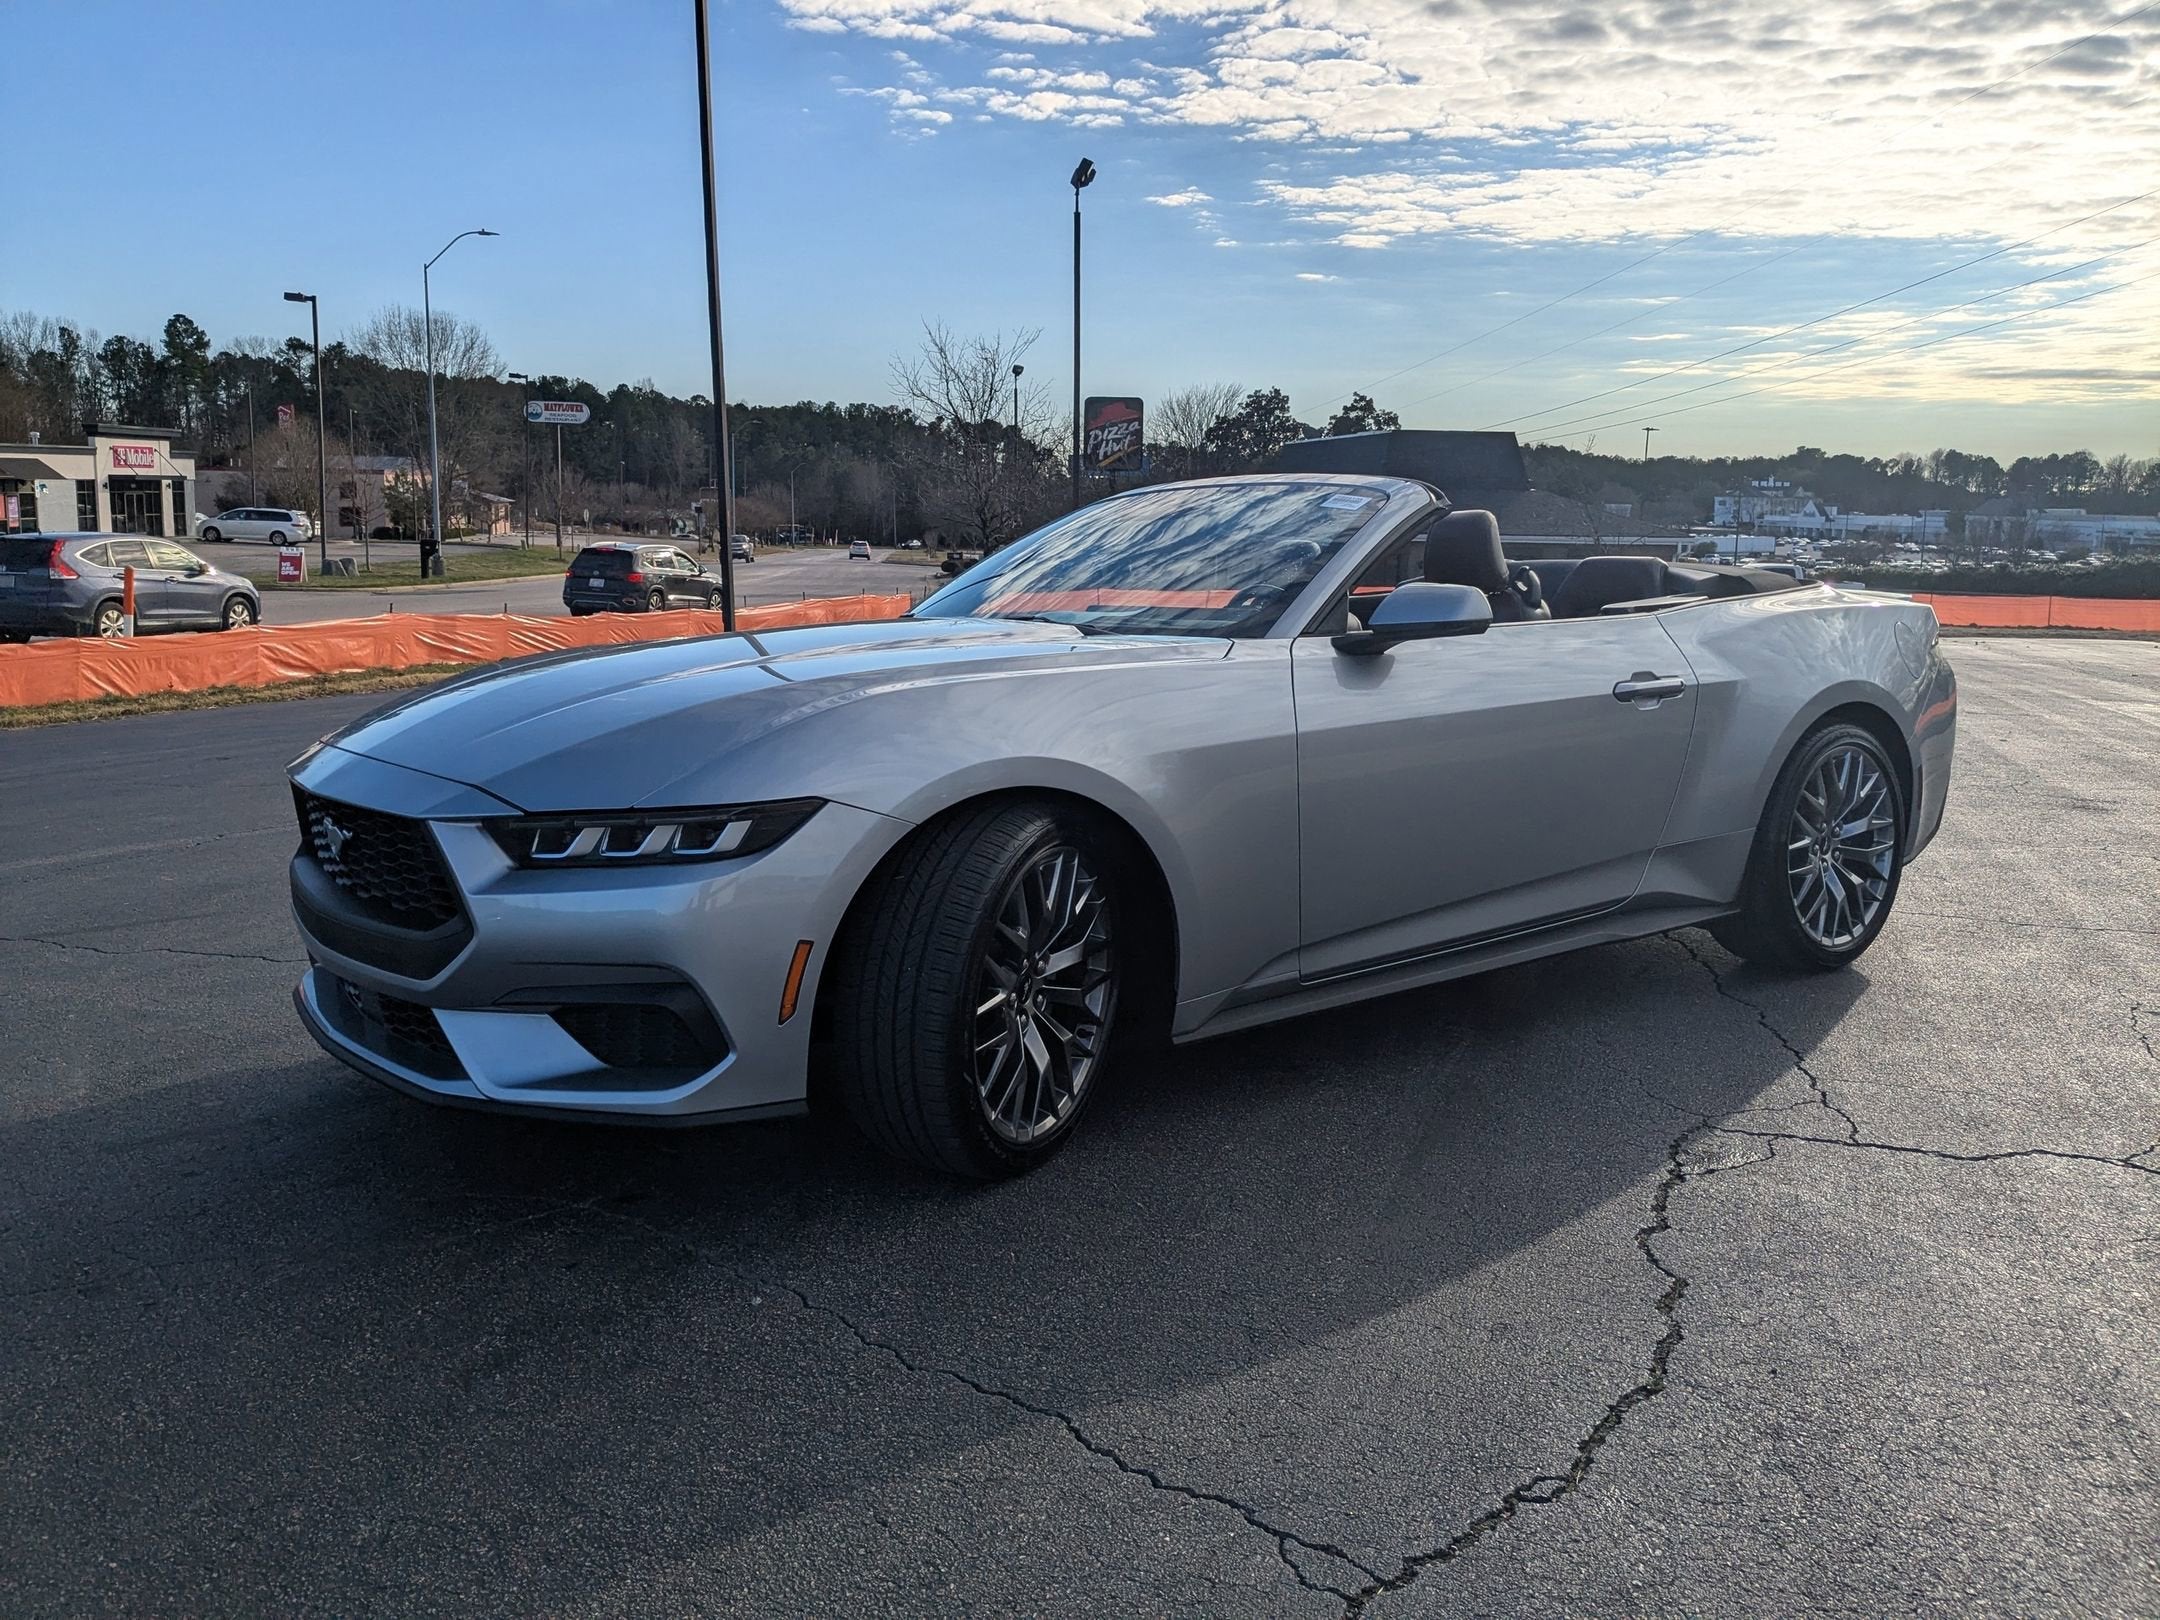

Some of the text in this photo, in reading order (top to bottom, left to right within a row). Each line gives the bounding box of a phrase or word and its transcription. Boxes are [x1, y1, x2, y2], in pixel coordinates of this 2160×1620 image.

[544, 403, 584, 412] MAYFLOWER
[1087, 421, 1141, 455] Pizza
[1097, 434, 1136, 460] Hut
